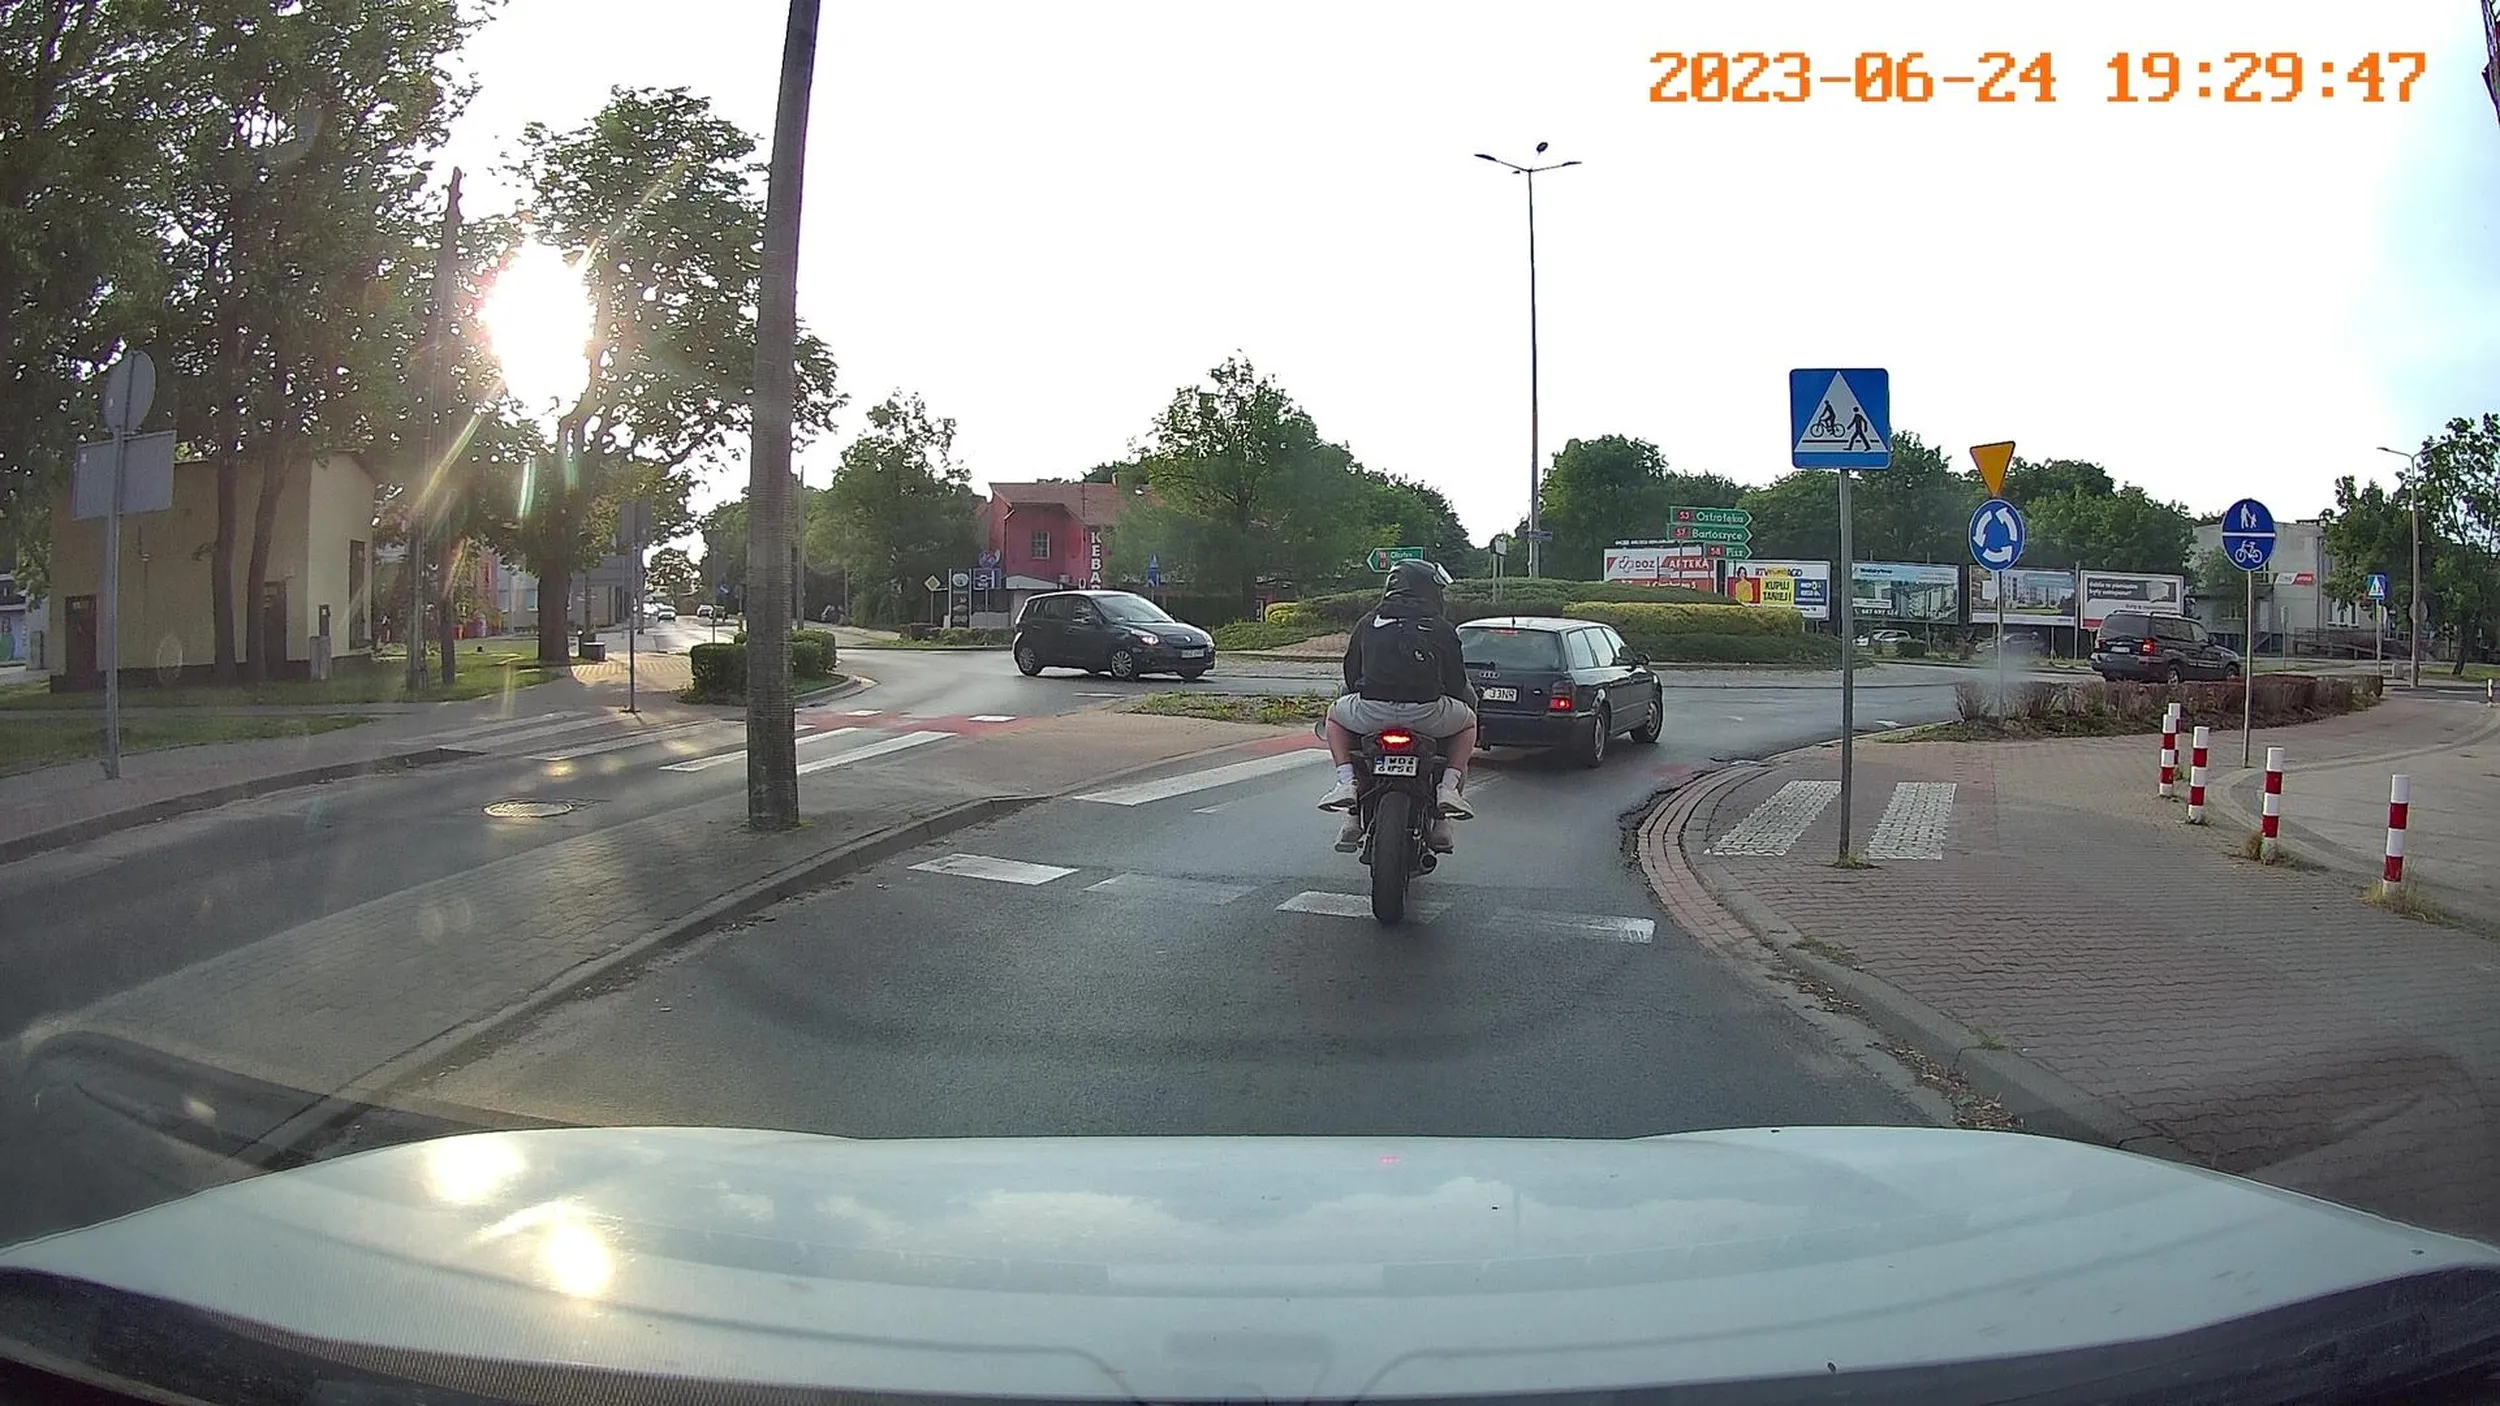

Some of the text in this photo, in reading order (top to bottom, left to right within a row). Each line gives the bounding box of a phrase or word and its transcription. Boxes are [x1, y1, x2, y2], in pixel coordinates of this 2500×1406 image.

[1696, 511, 1743, 526] Ostrołęka
[1692, 528, 1743, 541] Bartoszyce
[1635, 560, 1655, 568] DOZ
